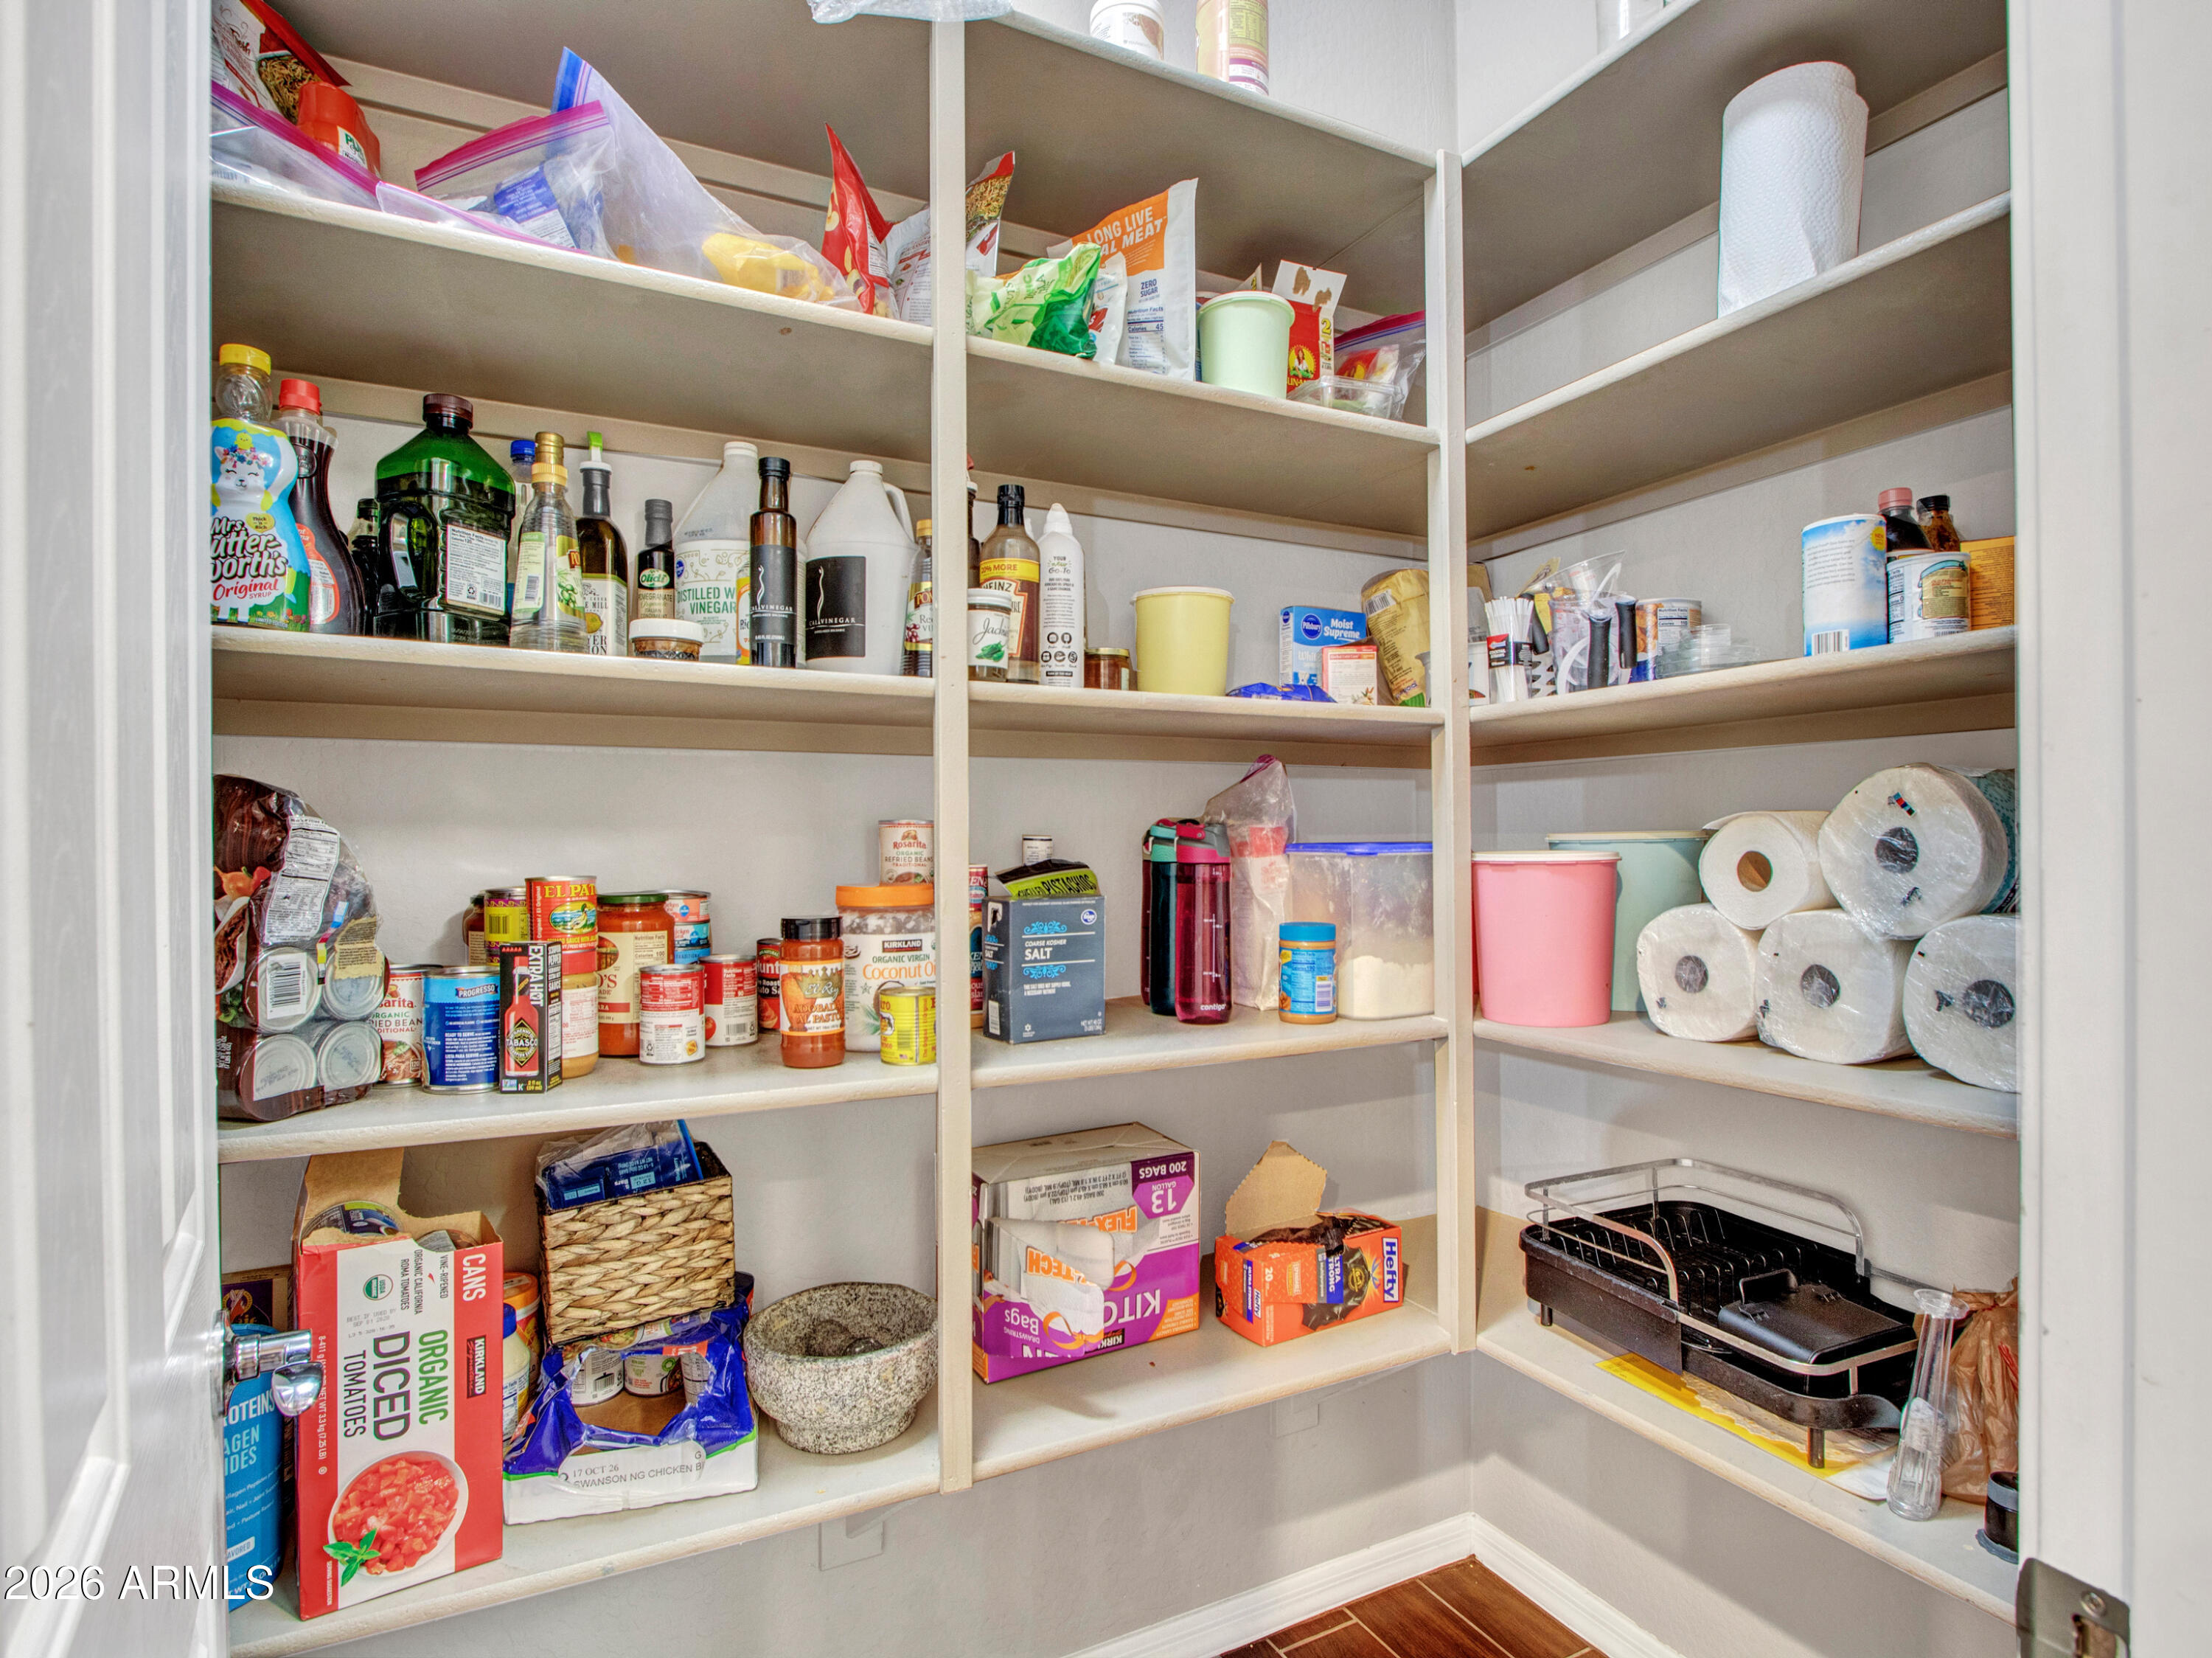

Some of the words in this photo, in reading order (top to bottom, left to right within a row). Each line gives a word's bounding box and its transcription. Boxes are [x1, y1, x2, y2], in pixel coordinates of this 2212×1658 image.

[1087, 221, 1121, 244] LONG
[1125, 207, 1153, 232] LIVE
[1101, 240, 1117, 255] AL
[1122, 218, 1163, 249] MEAT
[1140, 287, 1158, 297] SUGAR
[1141, 278, 1157, 290] ZERO
[211, 517, 247, 535] Mrs.
[211, 530, 282, 558] utter-
[981, 566, 992, 574] 20%
[992, 563, 1018, 572] MORE
[213, 578, 279, 601] Original
[982, 580, 1012, 592] HEINZ
[677, 587, 720, 603] DISTILLED
[690, 602, 737, 614] VINEGAR
[1302, 621, 1321, 633] Pillsbury
[1330, 618, 1354, 629] Moist
[1324, 625, 1360, 640] Supreme
[892, 841, 927, 850] Rosarita
[543, 885, 566, 898] EL
[569, 884, 597, 898] PAT
[883, 940, 921, 948] KIRKLAND
[872, 955, 905, 964] ORGANIC
[908, 954, 931, 962] VIRGIN
[985, 948, 994, 958] SALT
[1024, 947, 1053, 960] SALT
[529, 946, 543, 983] EXTRA
[862, 963, 922, 979] Coconut
[924, 962, 936, 977] Oi
[459, 985, 495, 998] PROGRESSO
[529, 984, 543, 1007] HOT
[821, 981, 839, 1003] Rey
[1200, 1003, 1225, 1011] contigo
[394, 1018, 422, 1027] BEAN
[1138, 1163, 1166, 1179] BAGS
[1169, 1161, 1186, 1174] 200
[1152, 1181, 1177, 1191] GALLON
[1151, 1188, 1178, 1214] 13
[1057, 1205, 1138, 1233] FLEX-
[400, 1258, 410, 1277] ROMA
[414, 1249, 423, 1276] ORGANIC
[1384, 1241, 1399, 1300] Hefty
[439, 1255, 449, 1299] VINE-RIPENED
[462, 1253, 487, 1302] CANS
[1265, 1266, 1273, 1282] 20
[1327, 1258, 1335, 1292] TRONG
[400, 1278, 410, 1311] TOMATOES
[414, 1277, 423, 1315] CALIFORNIA
[1103, 1288, 1161, 1328] KITC
[347, 1314, 361, 1322] BEST
[1004, 1309, 1039, 1335] Bags
[1004, 1327, 1040, 1344] DRAWSTRING
[1097, 1334, 1123, 1350] KIRK
[474, 1337, 486, 1395] KIRKLAND
[418, 1329, 449, 1425] ORGANIC
[343, 1350, 366, 1438] TOMATOES
[373, 1331, 411, 1441] DICED
[223, 1389, 276, 1426] OTEINS
[319, 1401, 327, 1412] WT
[319, 1414, 327, 1423] 3.3
[317, 1424, 327, 1432] kg
[224, 1424, 260, 1455] AGEN
[319, 1433, 327, 1447] (7.25
[224, 1446, 257, 1476] IDES
[319, 1449, 327, 1460] LB)
[572, 1468, 582, 1477] 17
[585, 1465, 607, 1475] OCT
[608, 1463, 619, 1472] 26
[574, 1474, 627, 1488] SWANSON
[630, 1471, 645, 1480] NG
[648, 1464, 693, 1478] CHICKEN
[227, 1541, 251, 1559] AVORED
